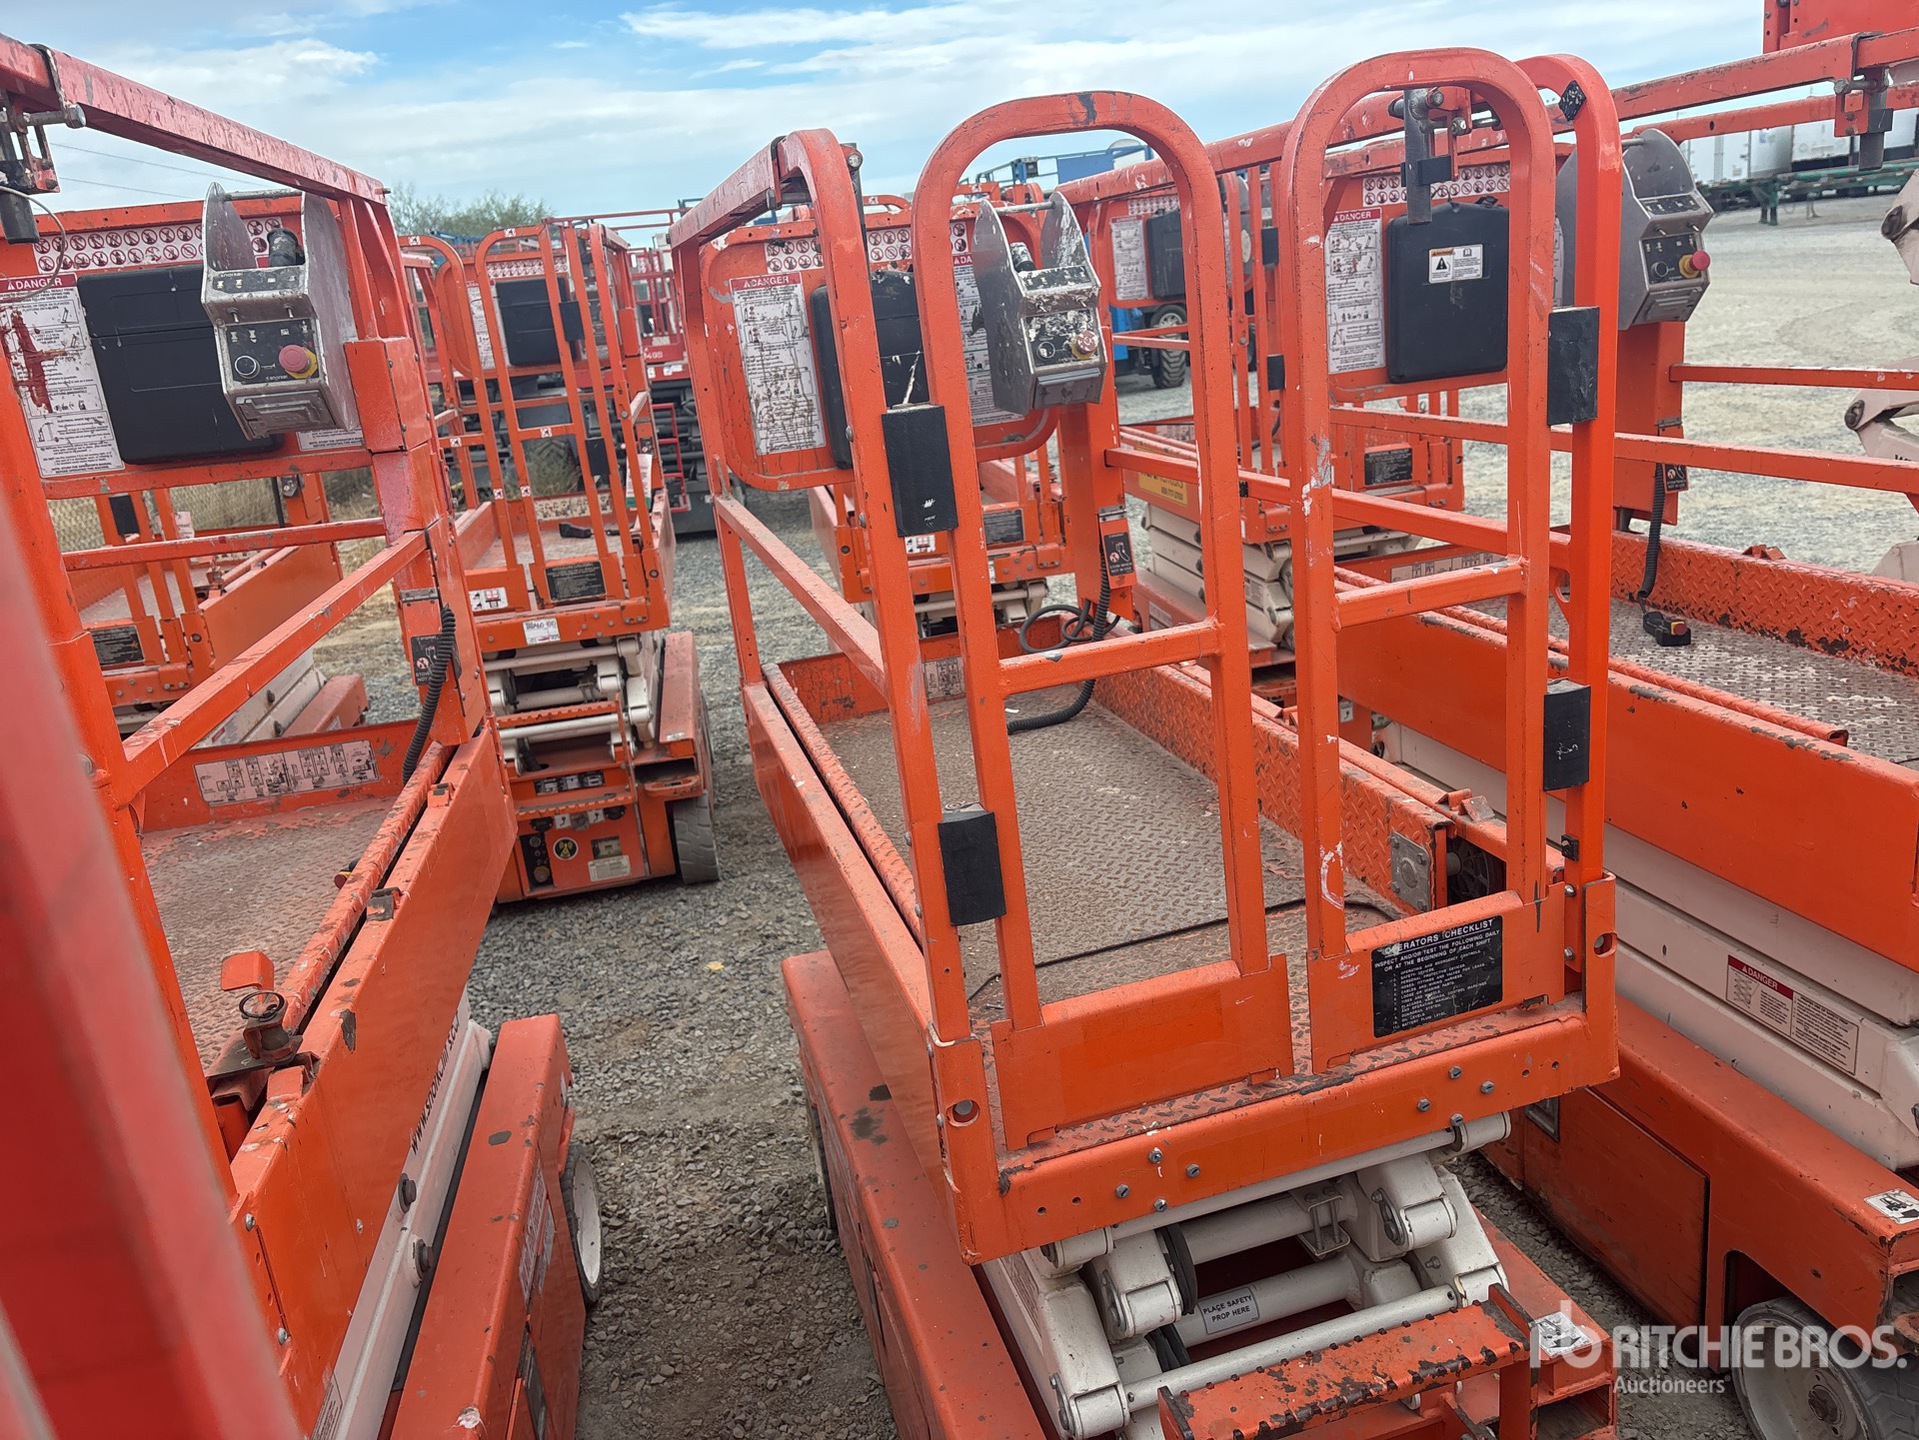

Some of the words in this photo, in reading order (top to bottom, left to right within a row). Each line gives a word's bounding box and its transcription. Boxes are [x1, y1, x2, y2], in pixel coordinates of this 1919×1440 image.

[1339, 211, 1372, 222] DANGER
[15, 277, 63, 290] DANGER
[1384, 934, 1438, 955] OERATORS
[1444, 919, 1493, 938] CHECKLIST
[1374, 957, 1397, 968] INSPECT
[1400, 951, 1421, 961] AND/OR
[1423, 947, 1436, 955] TEST
[1451, 934, 1482, 947] FOLLOWING
[1485, 929, 1499, 938] DAILY
[1416, 950, 1446, 963] BEGINNING
[1458, 943, 1473, 952] EACH
[1475, 938, 1490, 947] SHIFT
[1747, 967, 1778, 990] DANGER
[1203, 1303, 1226, 1314] PLACE
[1227, 1295, 1252, 1307] SAFETY
[1212, 1312, 1230, 1322] PROP
[1232, 1306, 1250, 1316] HERE
